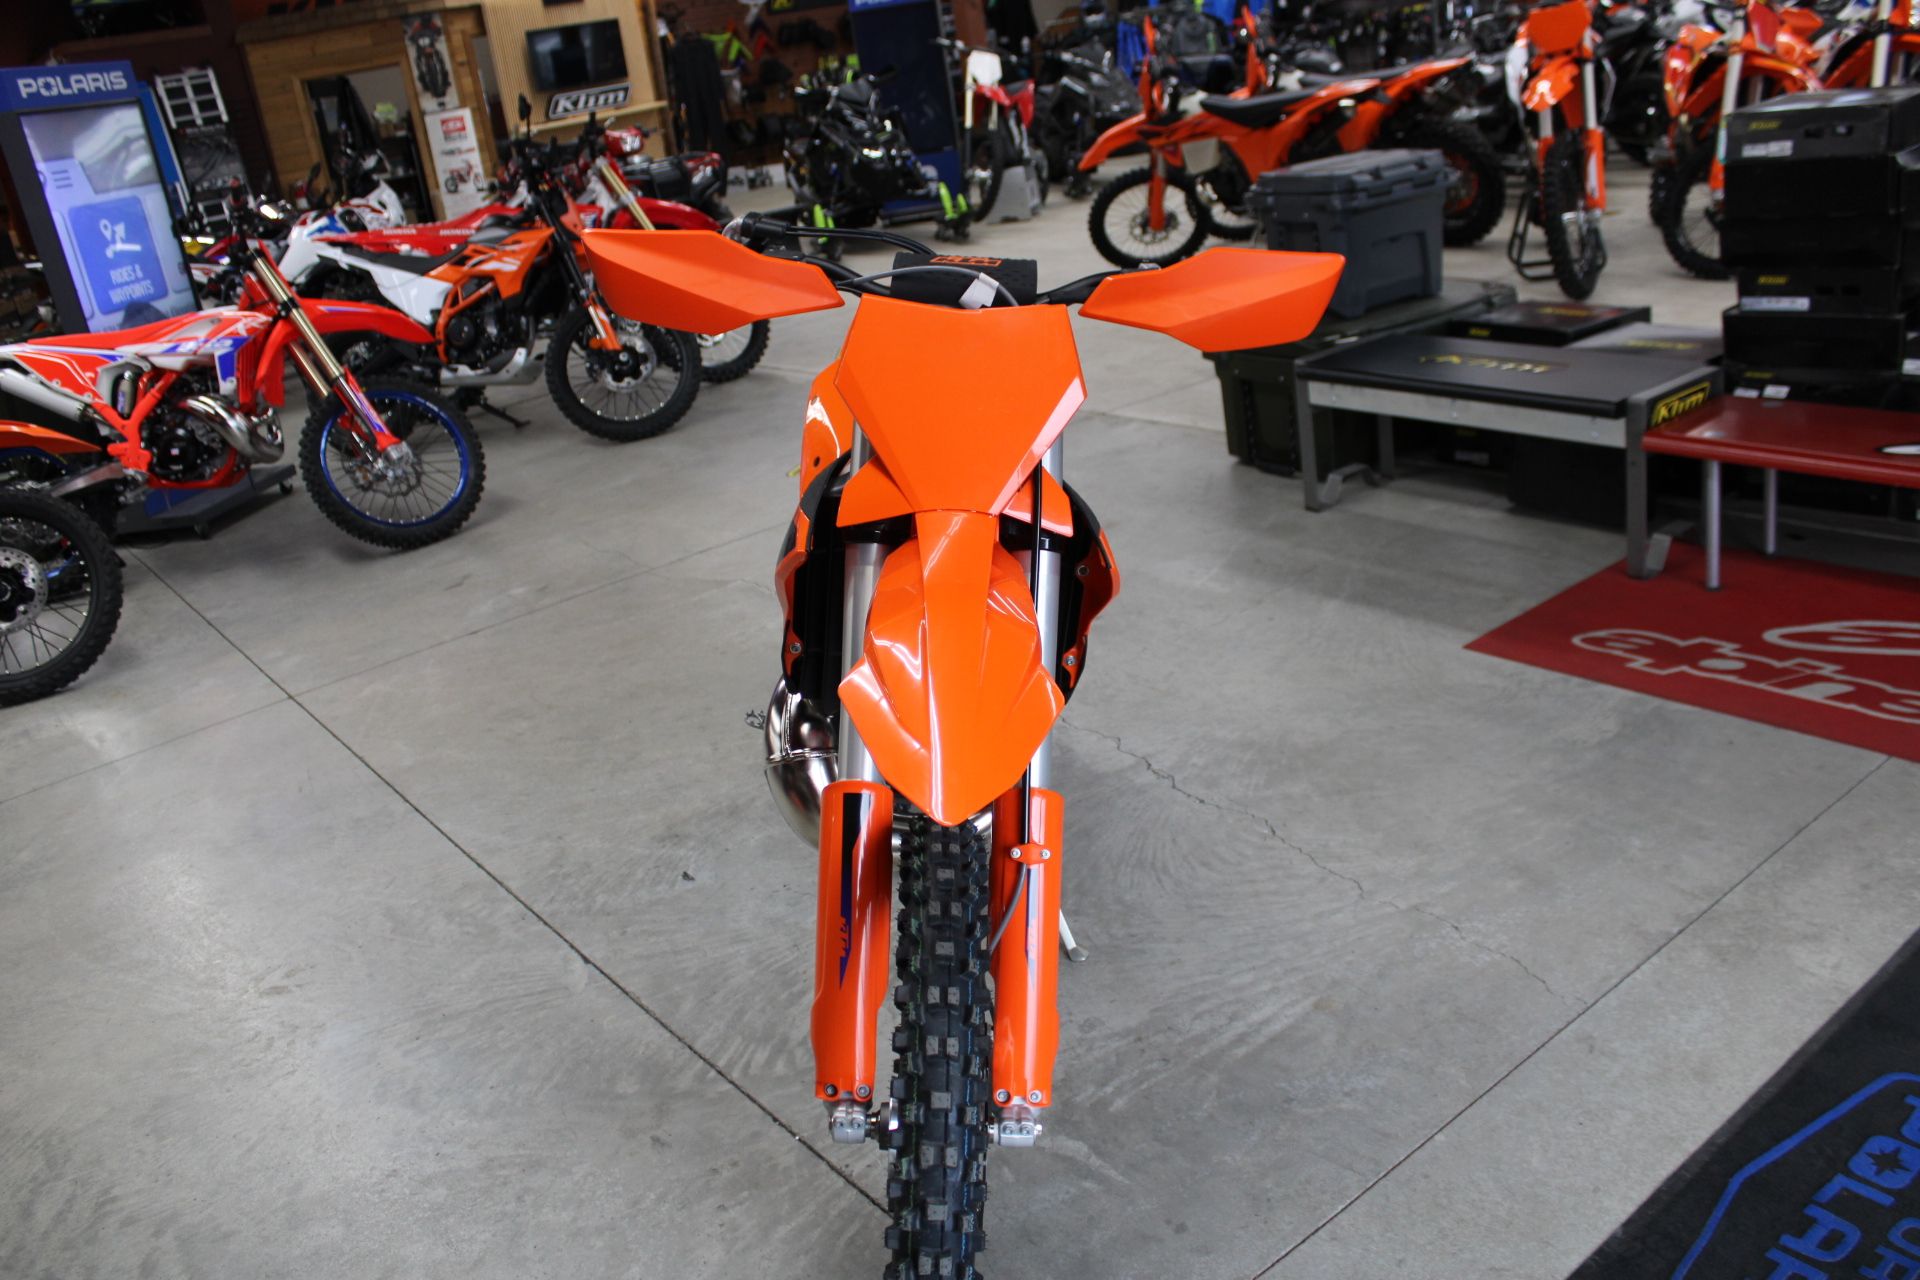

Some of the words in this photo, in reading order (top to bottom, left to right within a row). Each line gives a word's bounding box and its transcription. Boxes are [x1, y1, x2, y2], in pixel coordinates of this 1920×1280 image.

[17, 71, 128, 99] POLARIS
[110, 265, 136, 286] RIDES
[109, 280, 155, 304] WAYPOINTS
